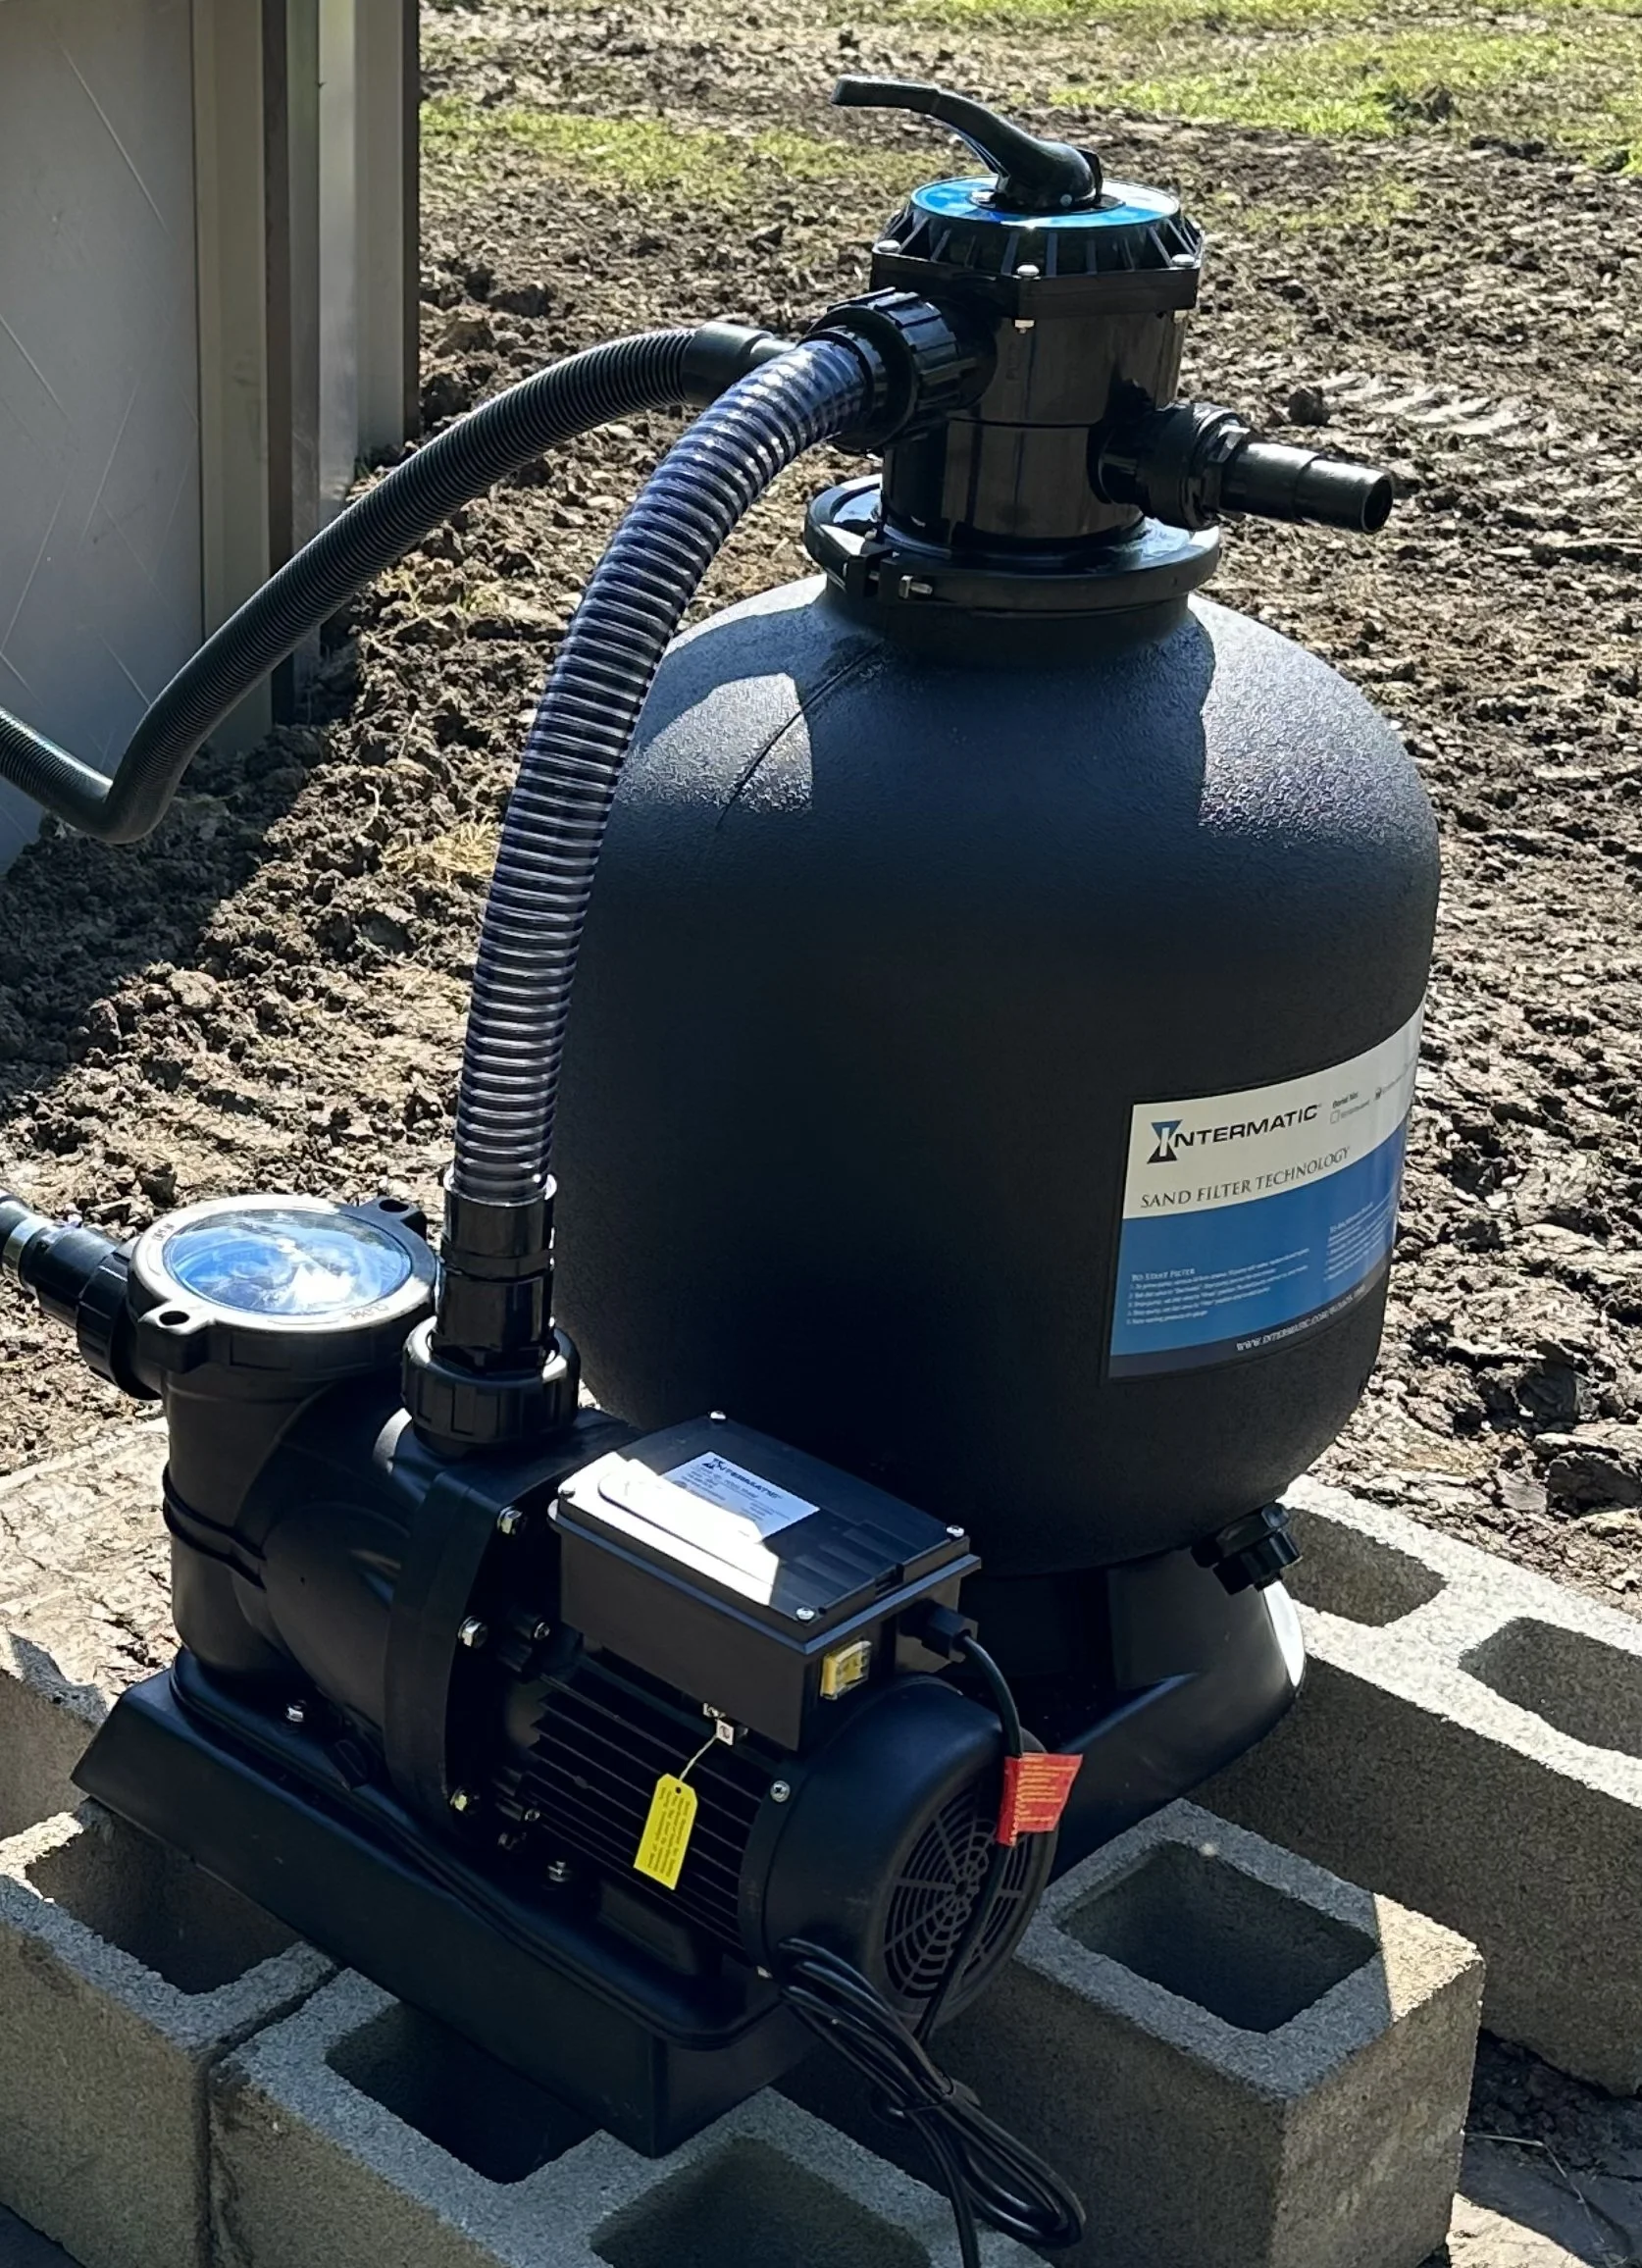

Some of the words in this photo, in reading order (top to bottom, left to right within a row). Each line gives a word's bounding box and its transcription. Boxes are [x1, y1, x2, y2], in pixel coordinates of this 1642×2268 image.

[1147, 1104, 1318, 1165] INTERMATIC
[1140, 1189, 1191, 1209] SAND
[1196, 1179, 1252, 1202] FILTER
[1255, 1146, 1351, 1190] TECHNOLOGY
